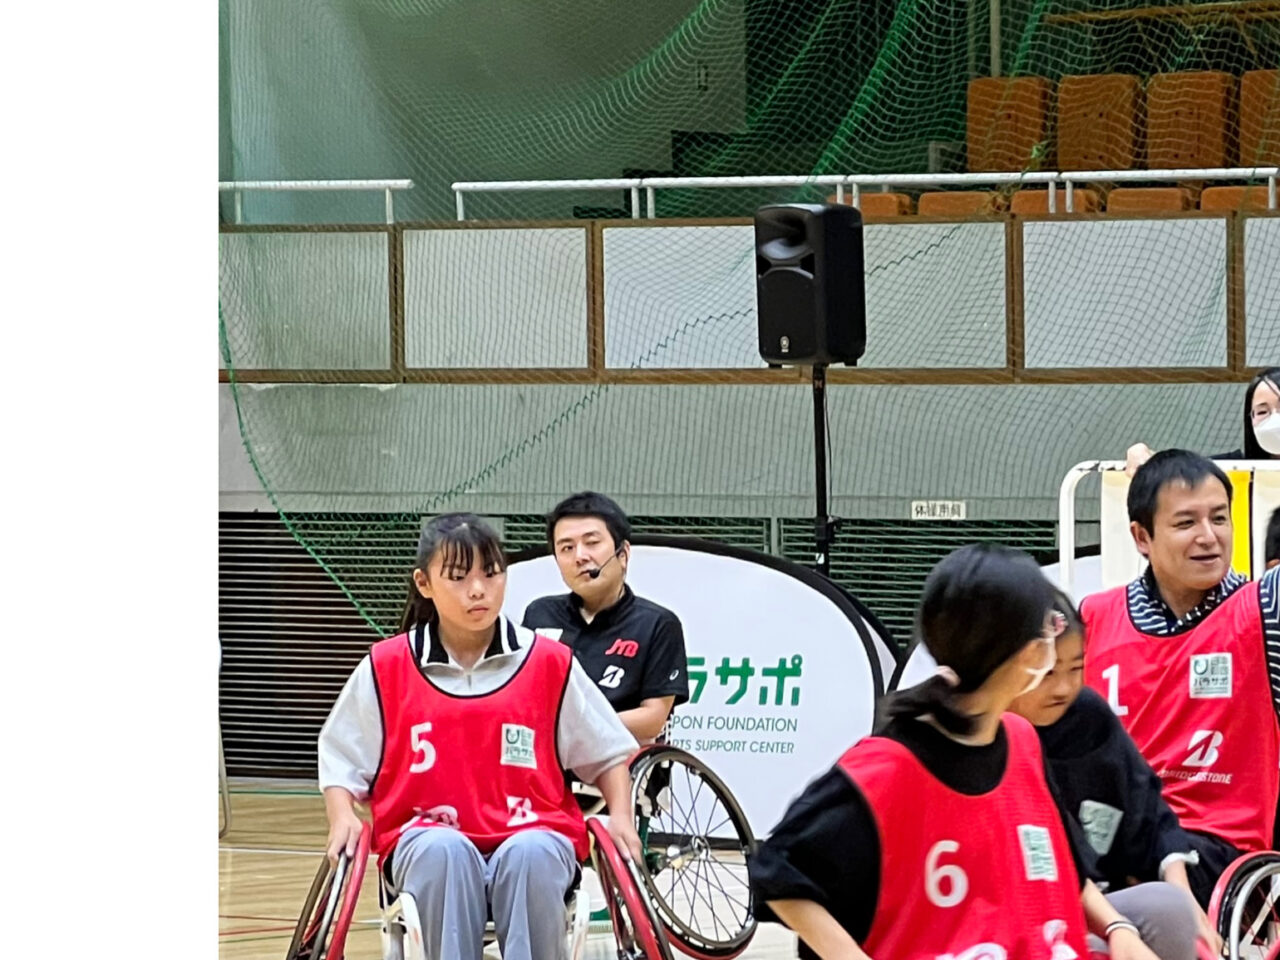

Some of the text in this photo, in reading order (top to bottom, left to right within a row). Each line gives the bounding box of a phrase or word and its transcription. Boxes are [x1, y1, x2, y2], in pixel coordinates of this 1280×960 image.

[1102, 664, 1129, 717] 1
[409, 722, 436, 773] 5
[695, 739, 747, 753] SUPPORT
[749, 741, 795, 754] CENTER
[707, 716, 798, 732] FOUNDATION
[924, 839, 969, 908] 6
